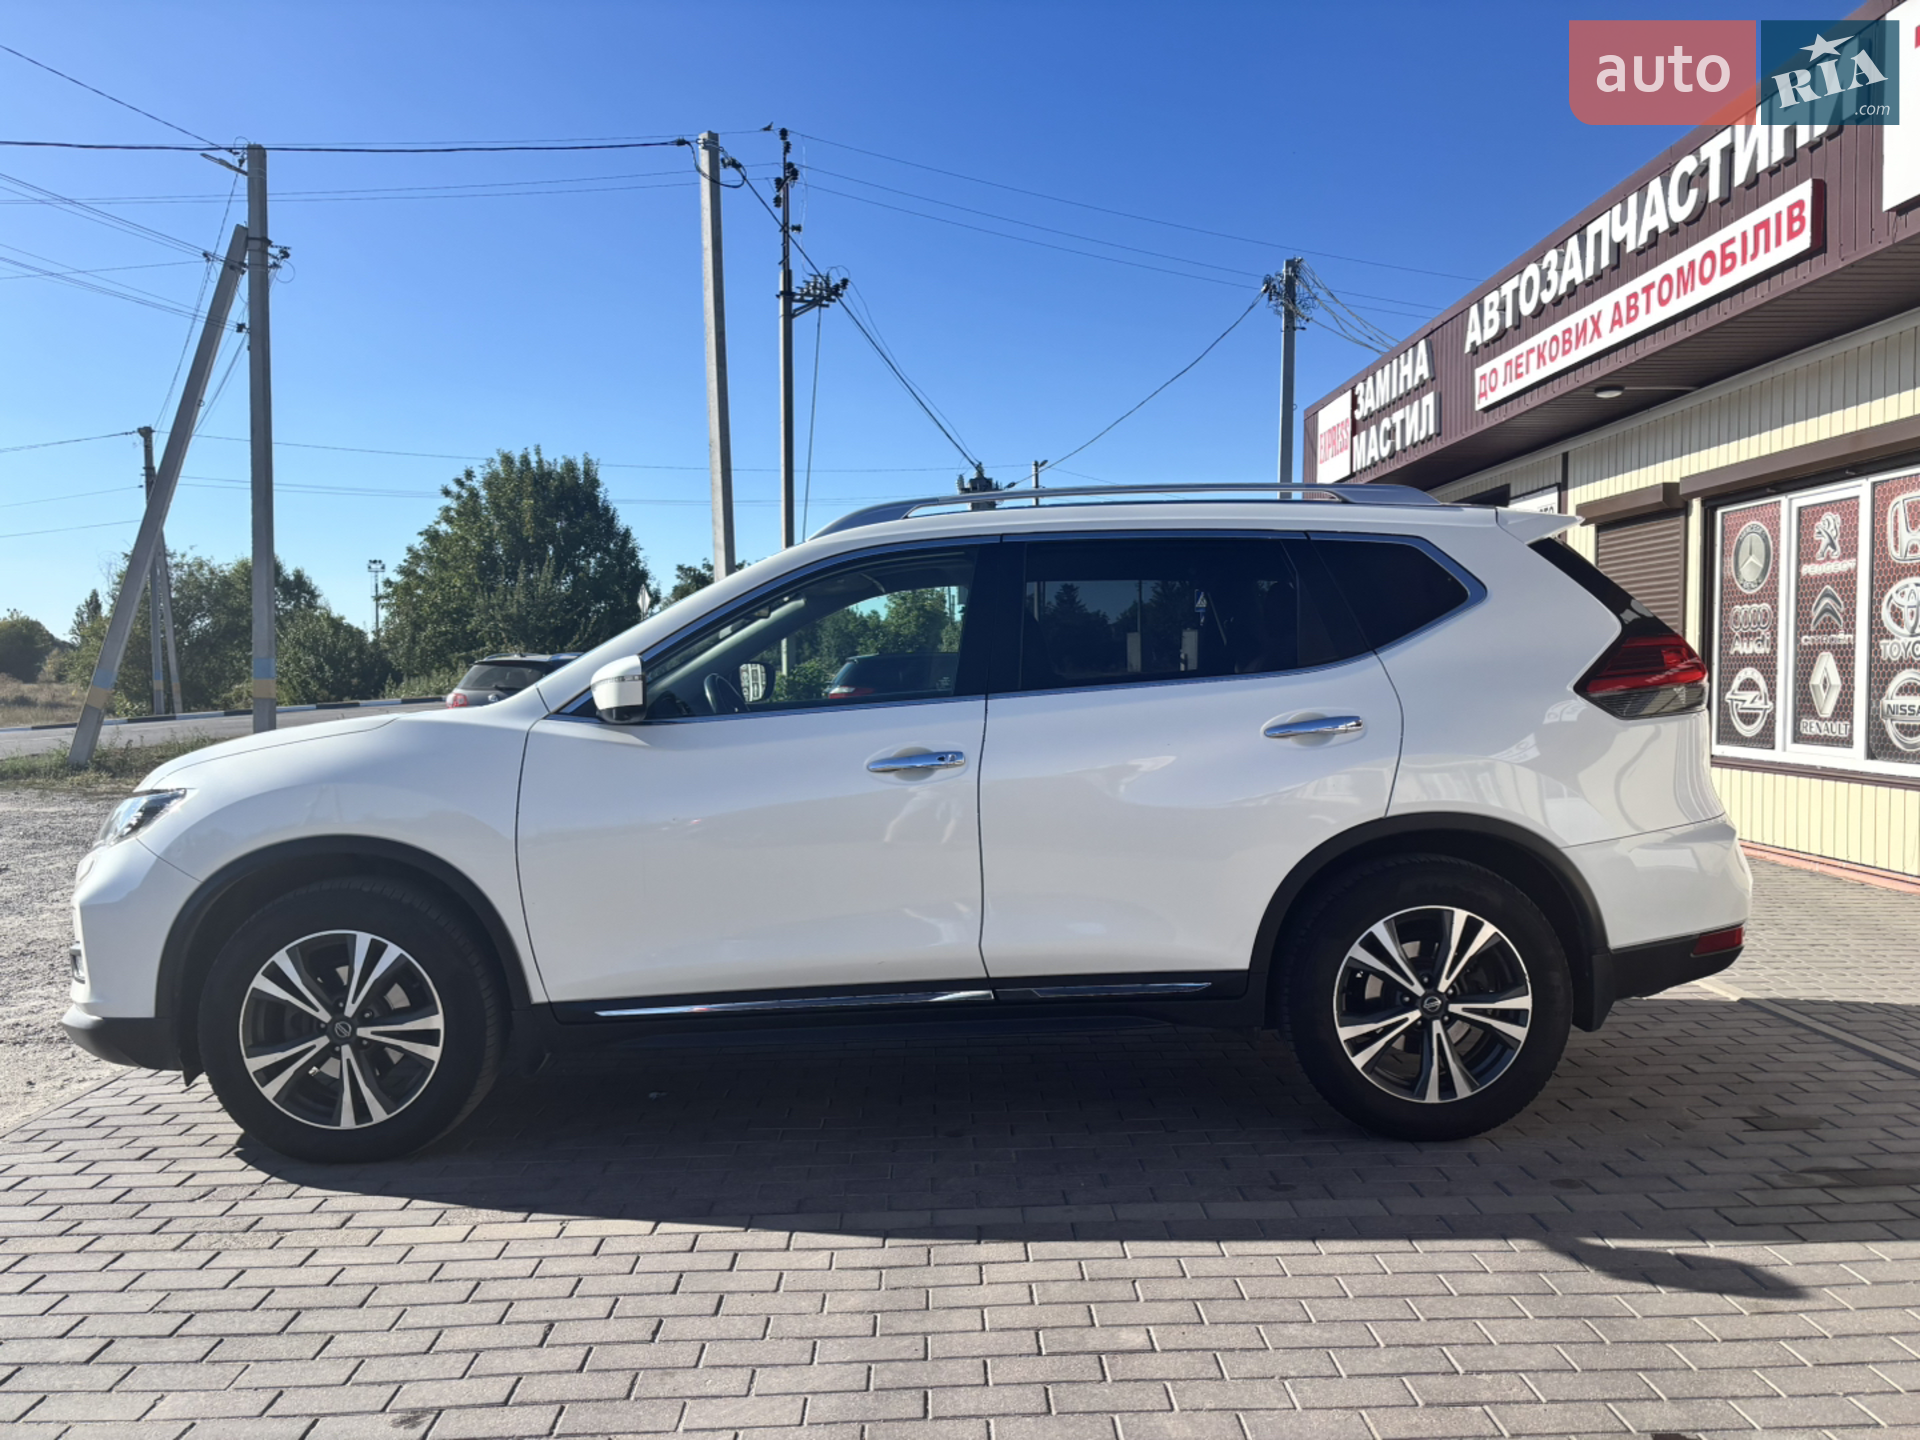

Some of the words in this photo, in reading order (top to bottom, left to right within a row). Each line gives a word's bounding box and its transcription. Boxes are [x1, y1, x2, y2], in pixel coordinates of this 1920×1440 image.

[1477, 367, 1499, 404] ДО
[1502, 310, 1603, 387] ЛЕГКОВИХ
[1608, 198, 1807, 334] АВТОМОБІЛІВ
[1353, 338, 1430, 421] ЗАМІНА
[1319, 417, 1350, 465] EXPRESS
[1352, 391, 1435, 473] МАСТИЛ
[1801, 558, 1856, 577] PEUGEOT
[1730, 631, 1771, 656] Audi
[1800, 718, 1850, 737] RENAULT
